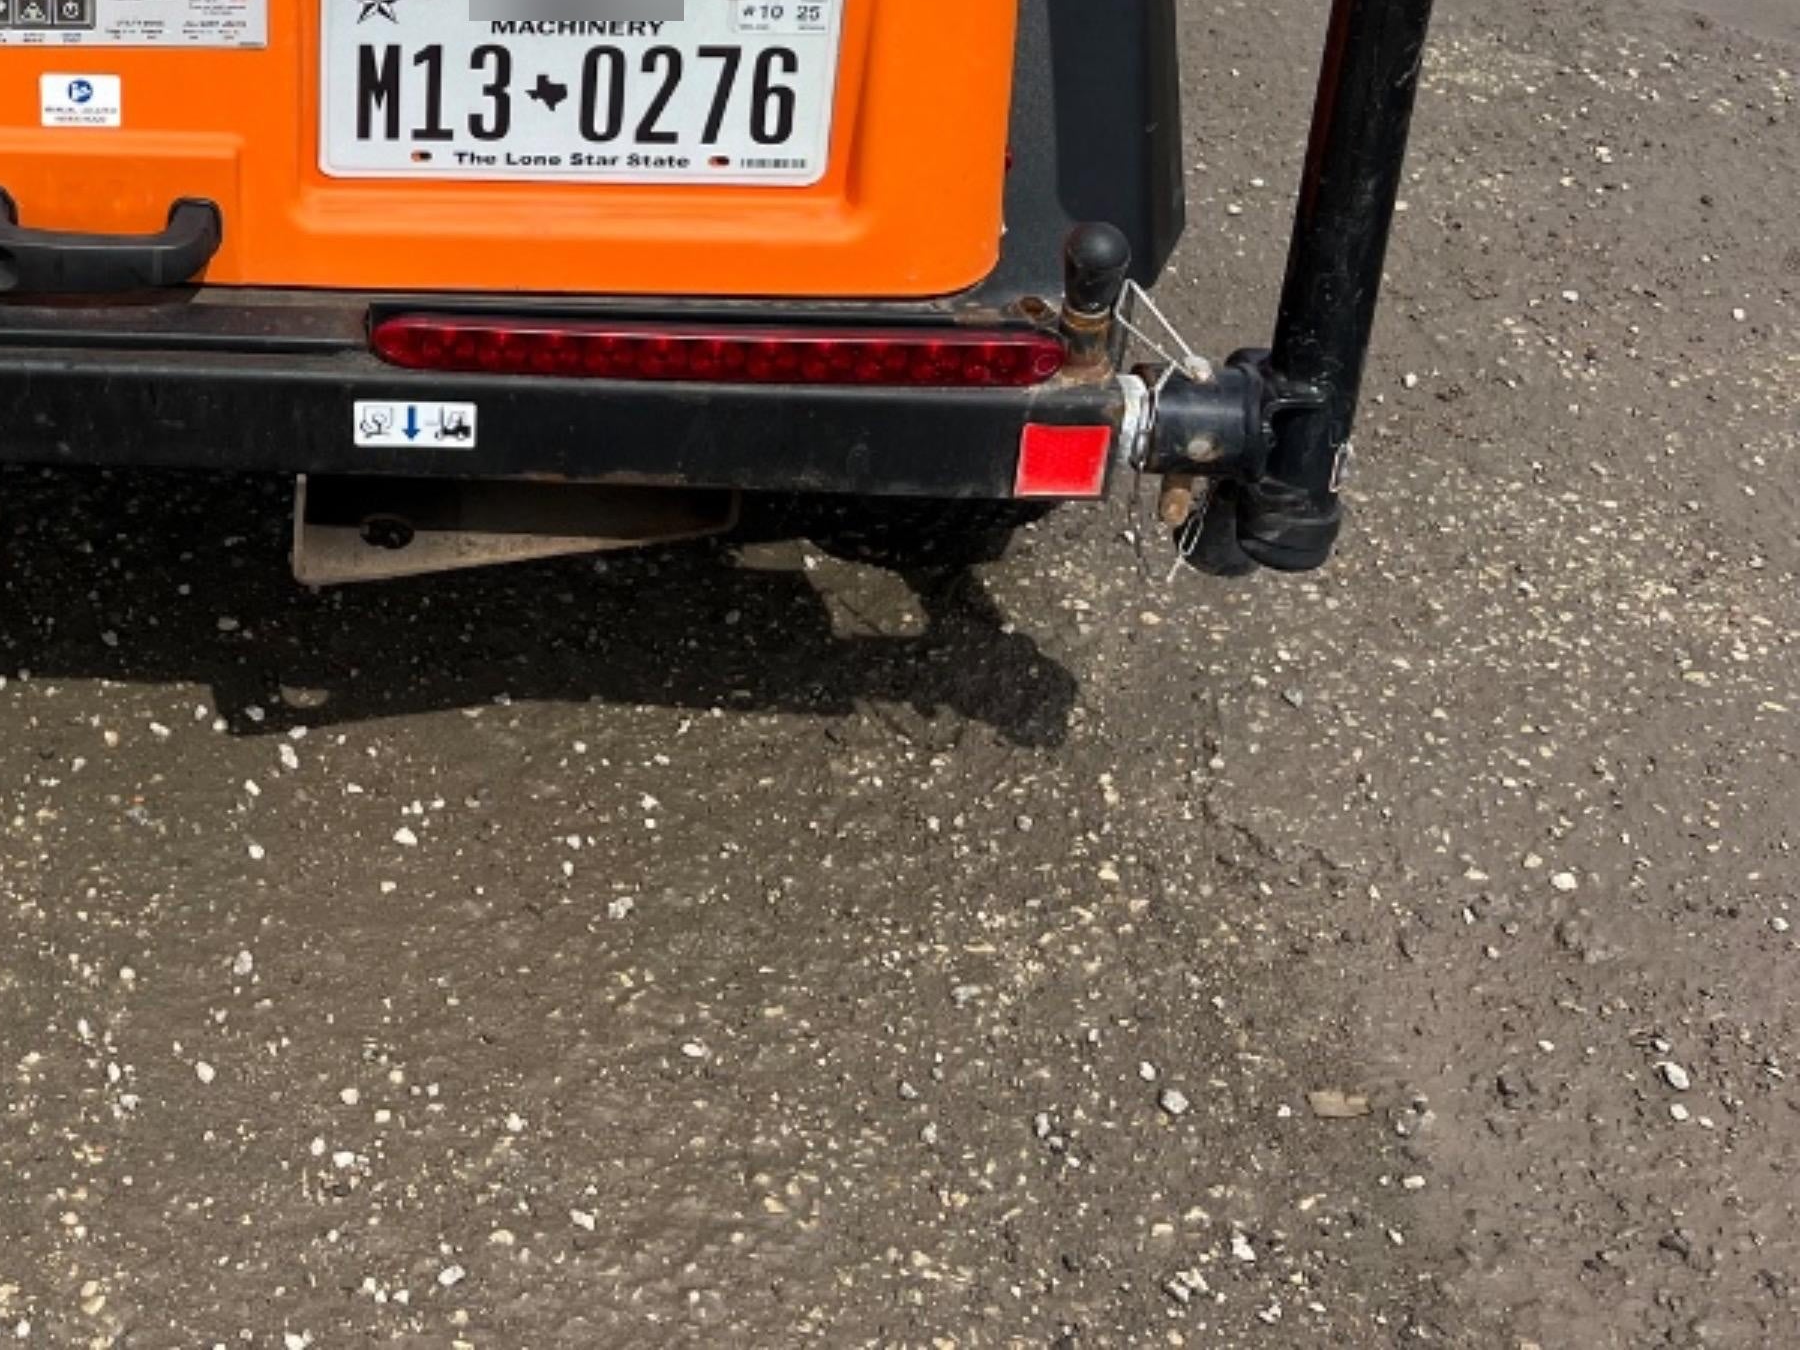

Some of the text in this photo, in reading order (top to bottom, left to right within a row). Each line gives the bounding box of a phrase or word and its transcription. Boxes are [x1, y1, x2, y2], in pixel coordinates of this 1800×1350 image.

[490, 19, 665, 37] MACHINERY
[453, 151, 690, 169] The Lone Star State
